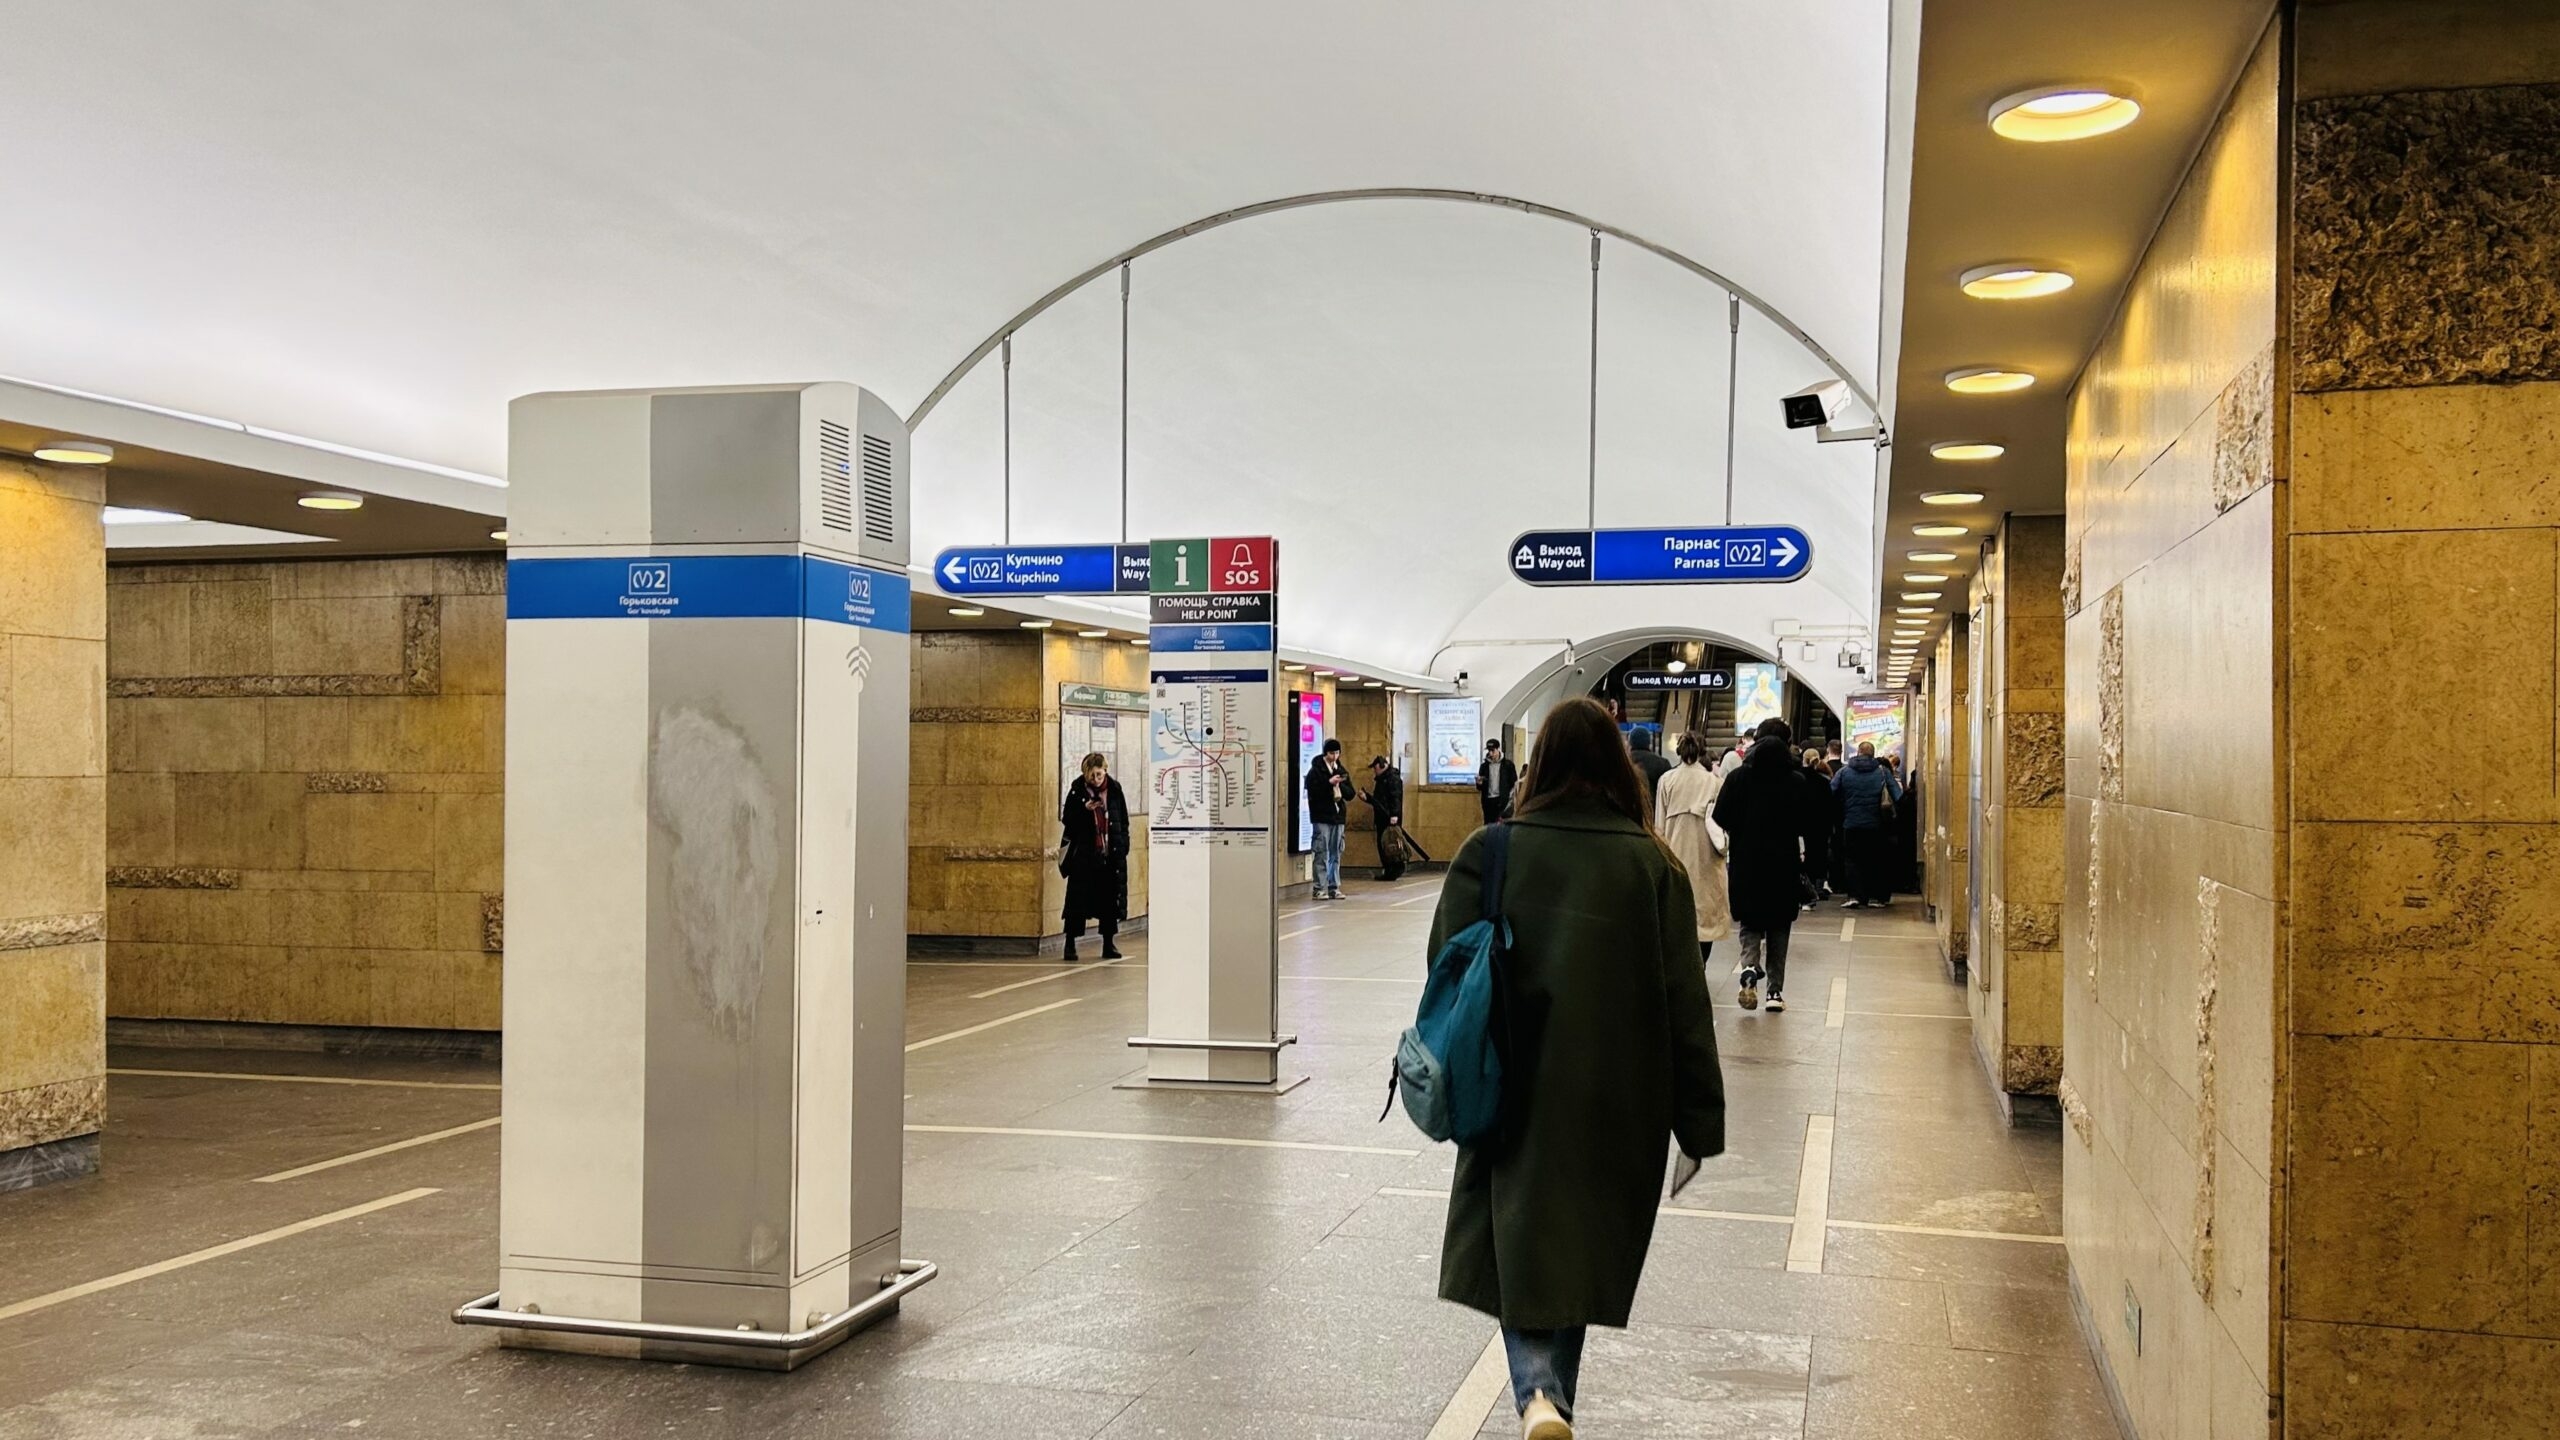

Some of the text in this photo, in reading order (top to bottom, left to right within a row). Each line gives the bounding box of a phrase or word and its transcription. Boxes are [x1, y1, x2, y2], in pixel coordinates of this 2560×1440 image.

[1539, 544, 1582, 557] Выход
[1664, 537, 1721, 554] Парнас
[1006, 553, 1064, 569] Купчино
[1123, 556, 1150, 567] Выхо
[1538, 557, 1586, 571] Way out
[1674, 557, 1720, 569] Parnas
[1006, 571, 1060, 586] Kupchino
[1122, 569, 1146, 581] Way
[1225, 570, 1260, 585] SOS
[619, 595, 679, 607] Горьковская
[1158, 596, 1261, 609] ПОМОЩЬ СПРАВКА
[1181, 609, 1238, 620] HELP POINT
[1632, 676, 1661, 685] Выход
[1663, 676, 1696, 685] Way out
